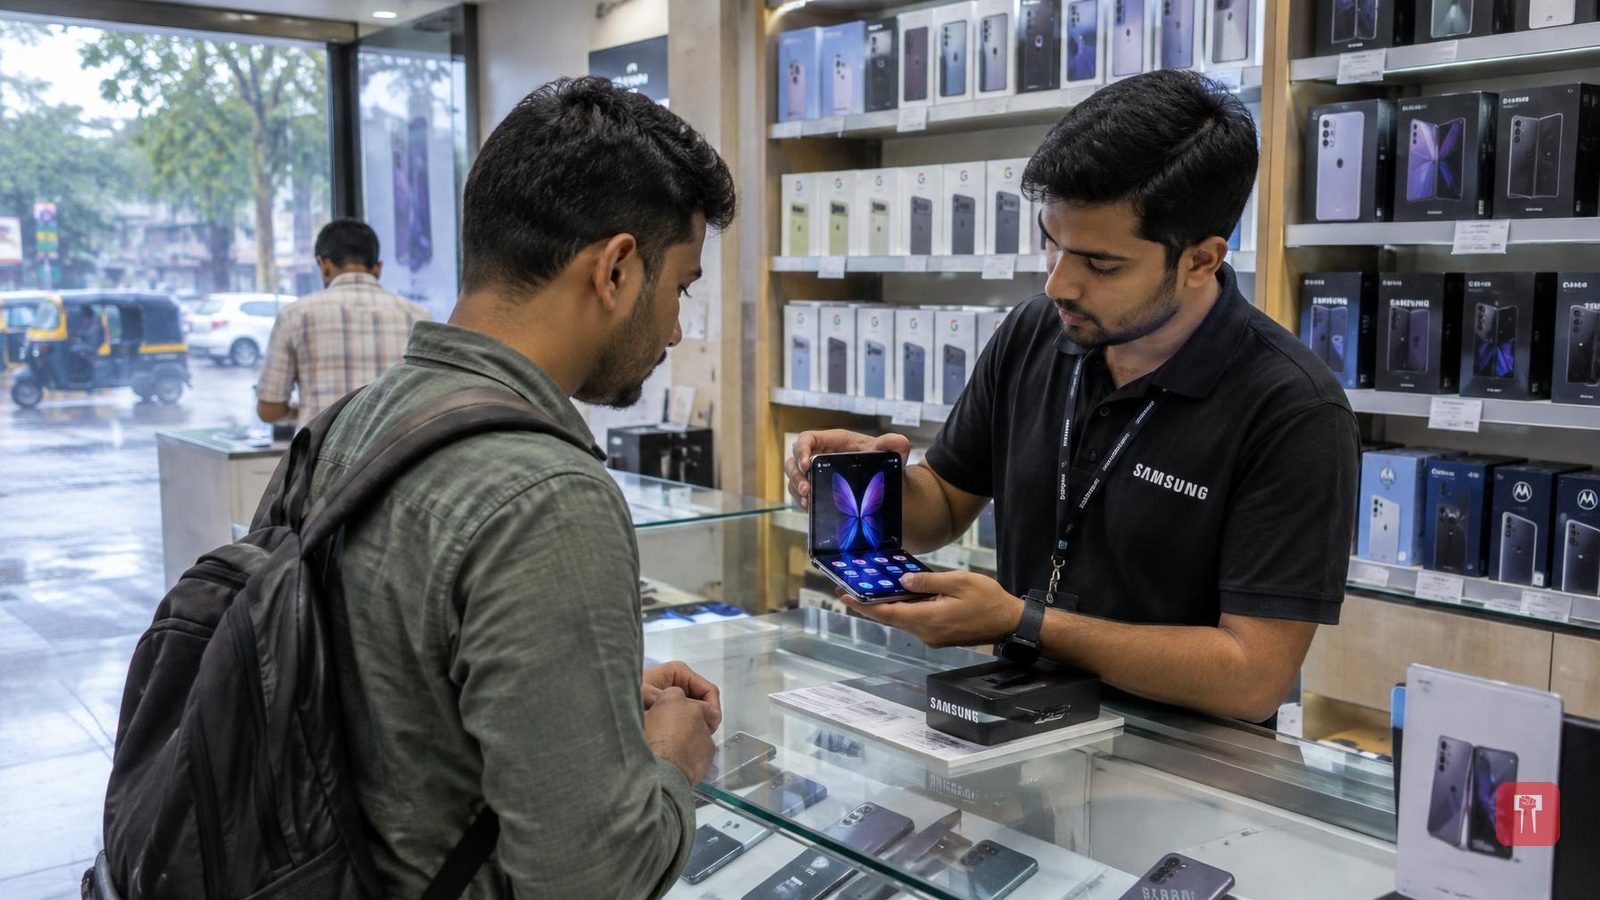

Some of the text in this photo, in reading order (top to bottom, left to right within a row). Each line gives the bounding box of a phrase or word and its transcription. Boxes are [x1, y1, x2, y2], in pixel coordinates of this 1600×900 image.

[1132, 463, 1209, 500] SAMSUNG
[1513, 483, 1531, 501] M
[1578, 490, 1597, 508] M
[930, 697, 979, 724] SAMSUNG
